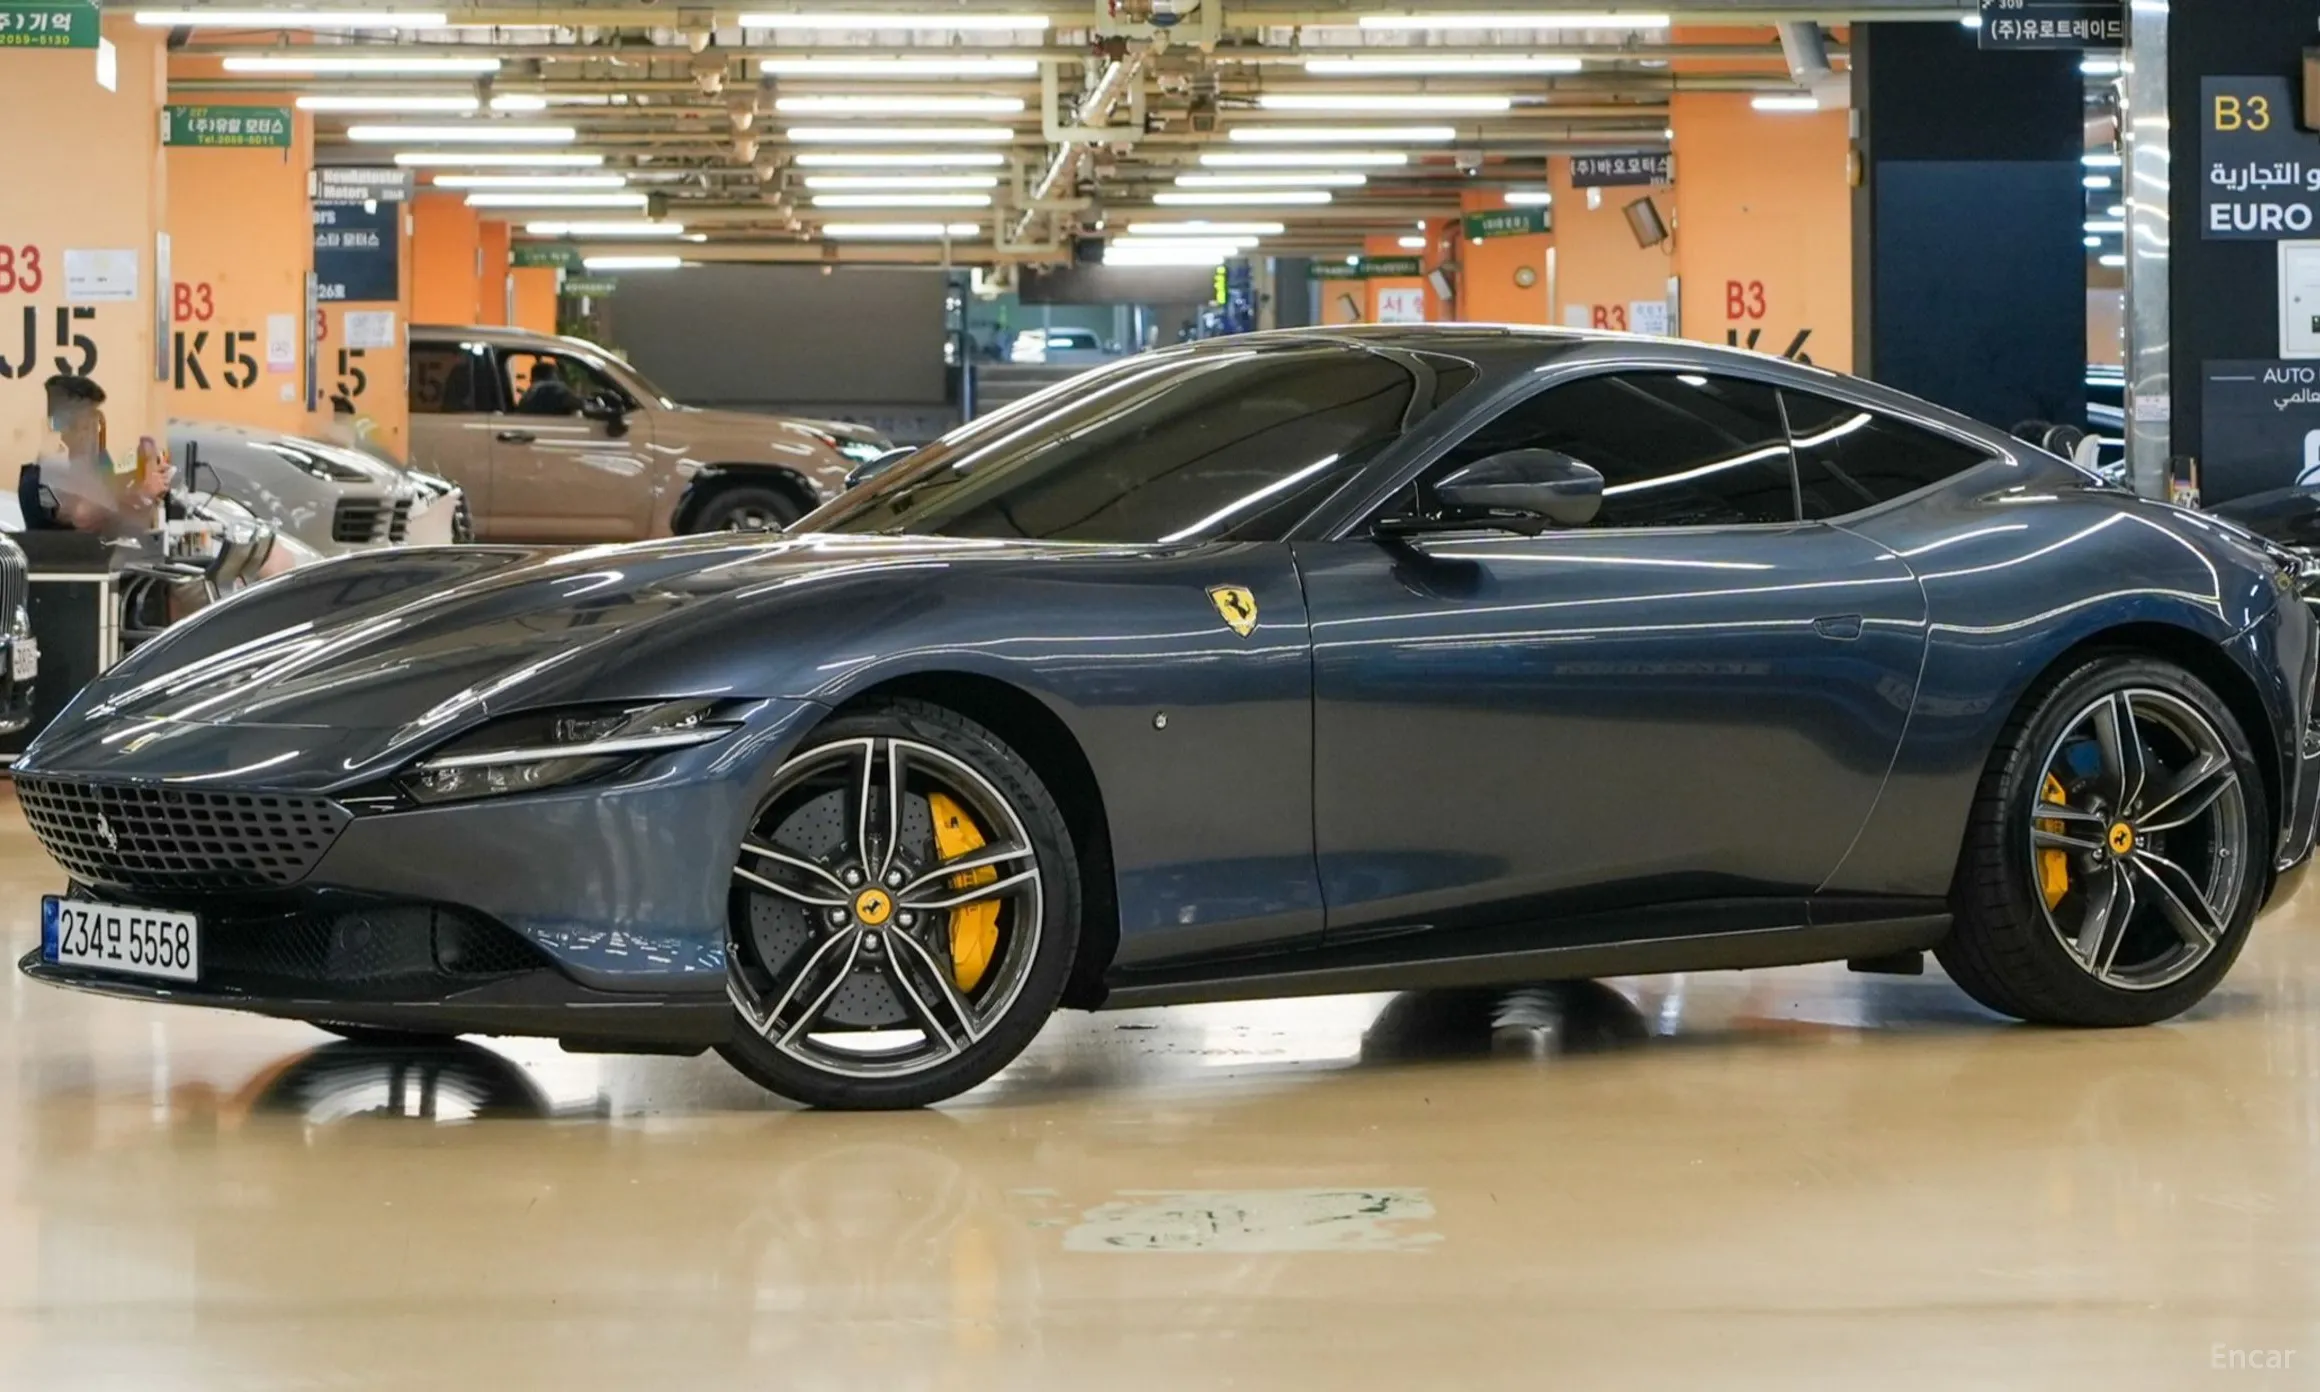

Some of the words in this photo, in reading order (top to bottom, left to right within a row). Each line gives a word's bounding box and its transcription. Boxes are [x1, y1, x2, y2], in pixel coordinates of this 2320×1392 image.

[1991, 19, 2123, 41] (주)유로트레이드
[2215, 95, 2270, 131] B3
[2210, 162, 2300, 191] التجارية
[2210, 203, 2313, 231] EURO
[174, 282, 214, 322] B3
[1727, 281, 1766, 320] B3
[174, 331, 259, 389] K5
[2263, 367, 2315, 384] AUTO
[61, 908, 122, 960] 234모
[130, 917, 191, 970] 5558
